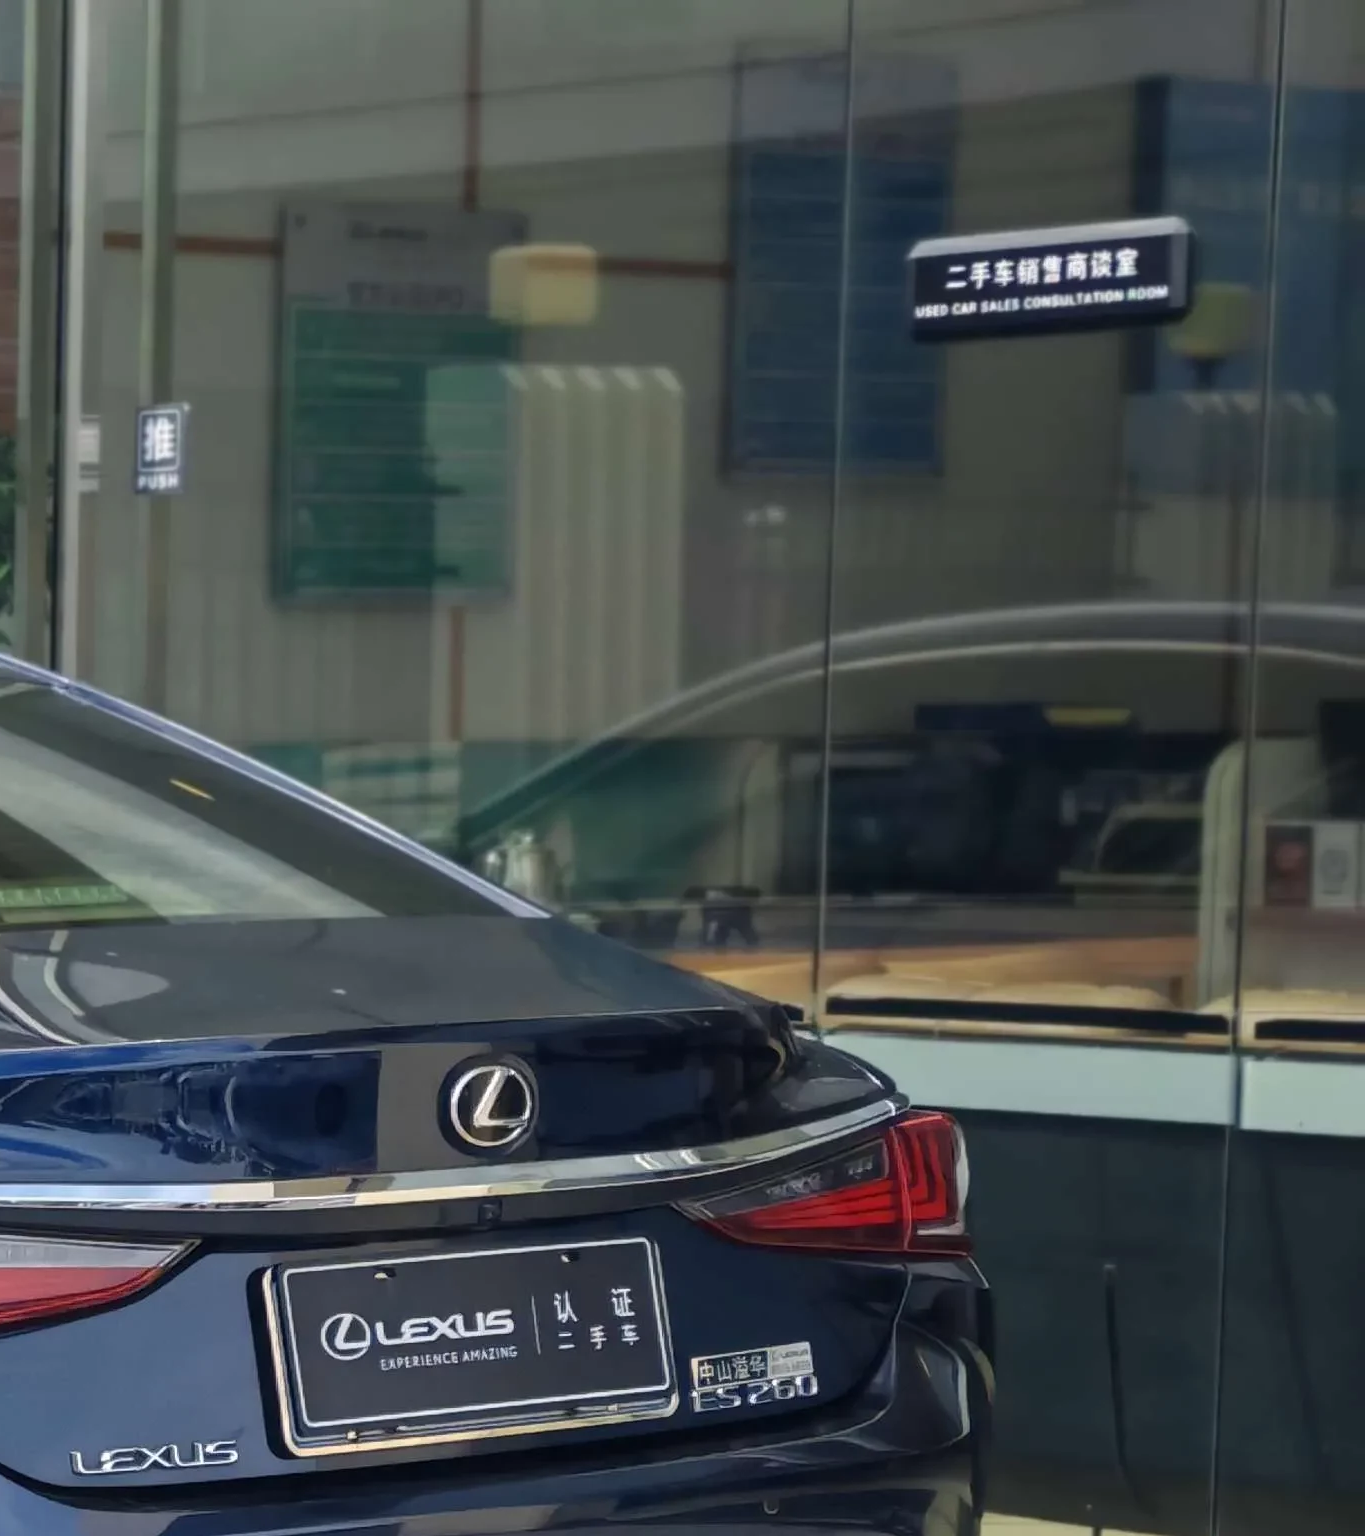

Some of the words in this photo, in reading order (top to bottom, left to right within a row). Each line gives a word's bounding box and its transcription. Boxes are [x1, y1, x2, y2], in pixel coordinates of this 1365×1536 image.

[945, 247, 1139, 290] 二手车销售商谈室
[914, 304, 949, 319] USED
[951, 302, 977, 316] CAR
[980, 297, 1020, 314] SALES
[1023, 288, 1124, 310] CONSULTATION
[1126, 285, 1168, 301] ROOM
[143, 416, 176, 463] 推
[138, 473, 179, 491] PUSH
[375, 1309, 514, 1345] LEXUS
[558, 1324, 640, 1350] 二手车
[380, 1351, 459, 1371] EXPERIENCE
[462, 1346, 518, 1362] AMAZING
[692, 1386, 742, 1413] ES
[748, 1375, 818, 1405] 260
[70, 1440, 239, 1474] LEXUS
